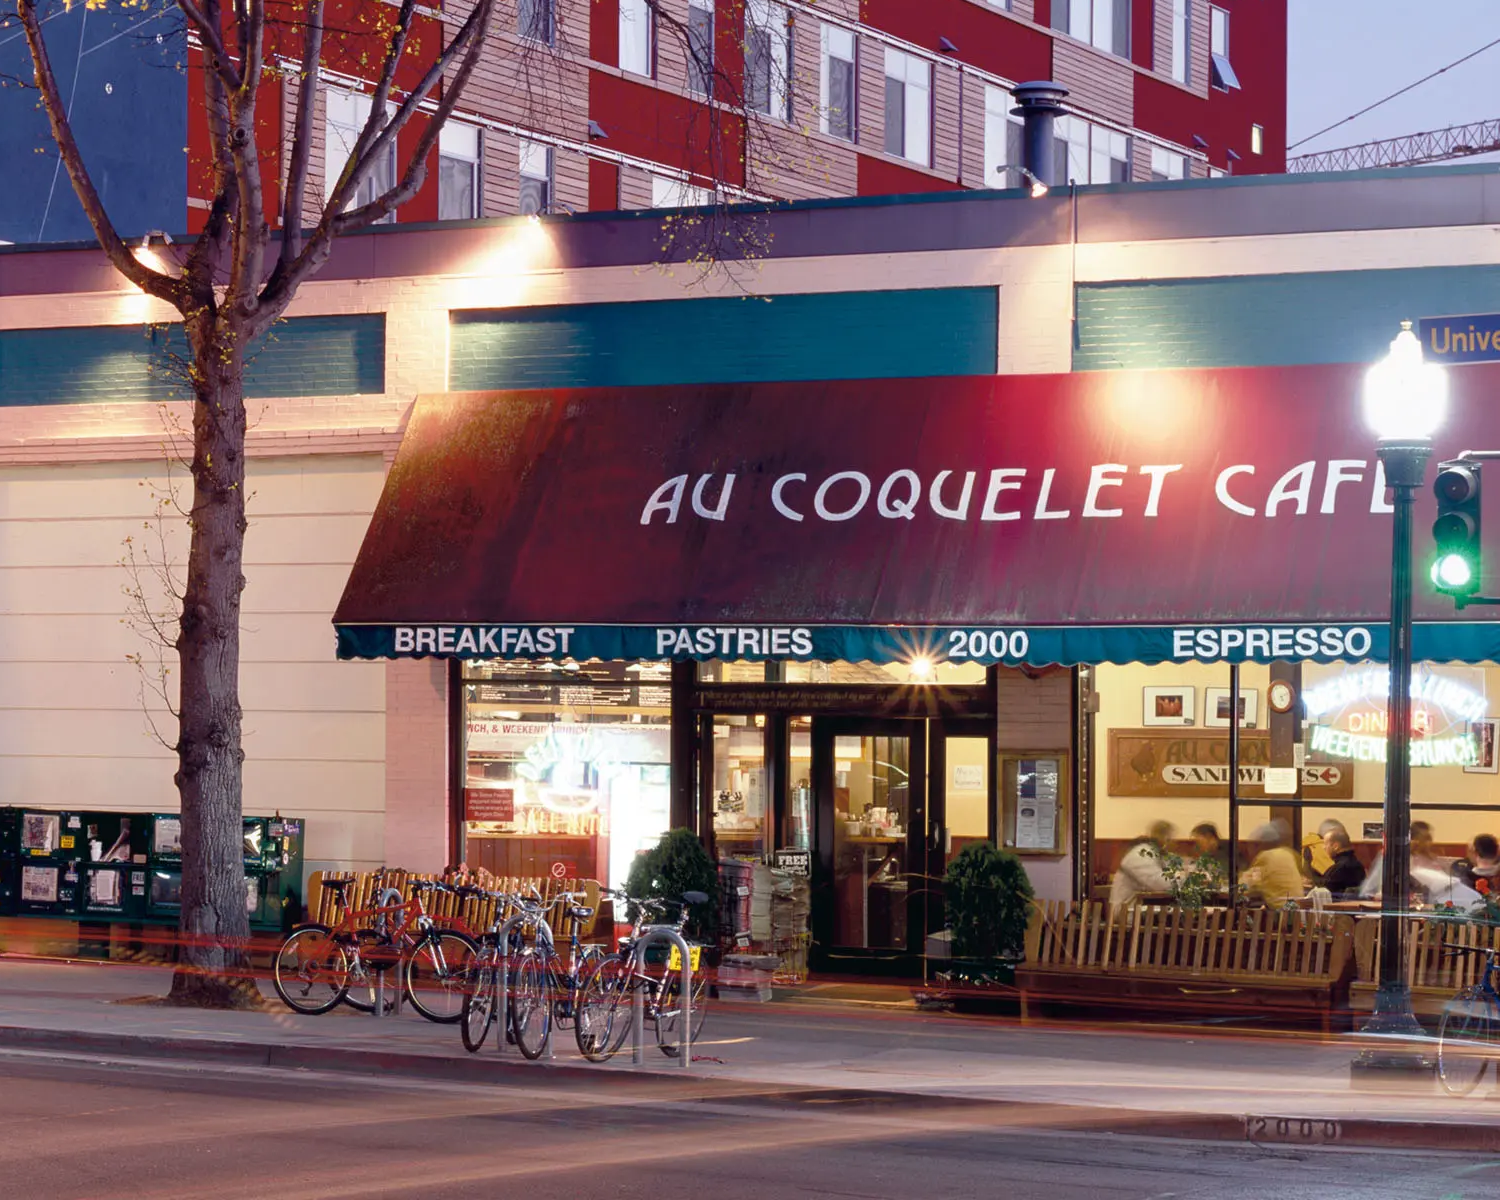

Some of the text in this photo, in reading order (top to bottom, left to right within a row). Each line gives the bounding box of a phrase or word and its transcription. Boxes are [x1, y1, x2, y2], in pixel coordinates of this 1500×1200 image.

[1430, 325, 1500, 354] Unive
[640, 472, 736, 525] AU
[771, 463, 1183, 522] COQUELET
[394, 627, 1372, 658] BREAKFAST PASTRIES 2000 ESPRESSO
[1348, 711, 1429, 732] DINR
[1172, 767, 1320, 783] SANWIS
[778, 855, 808, 865] FREE
[1254, 1119, 1337, 1139] 2000
